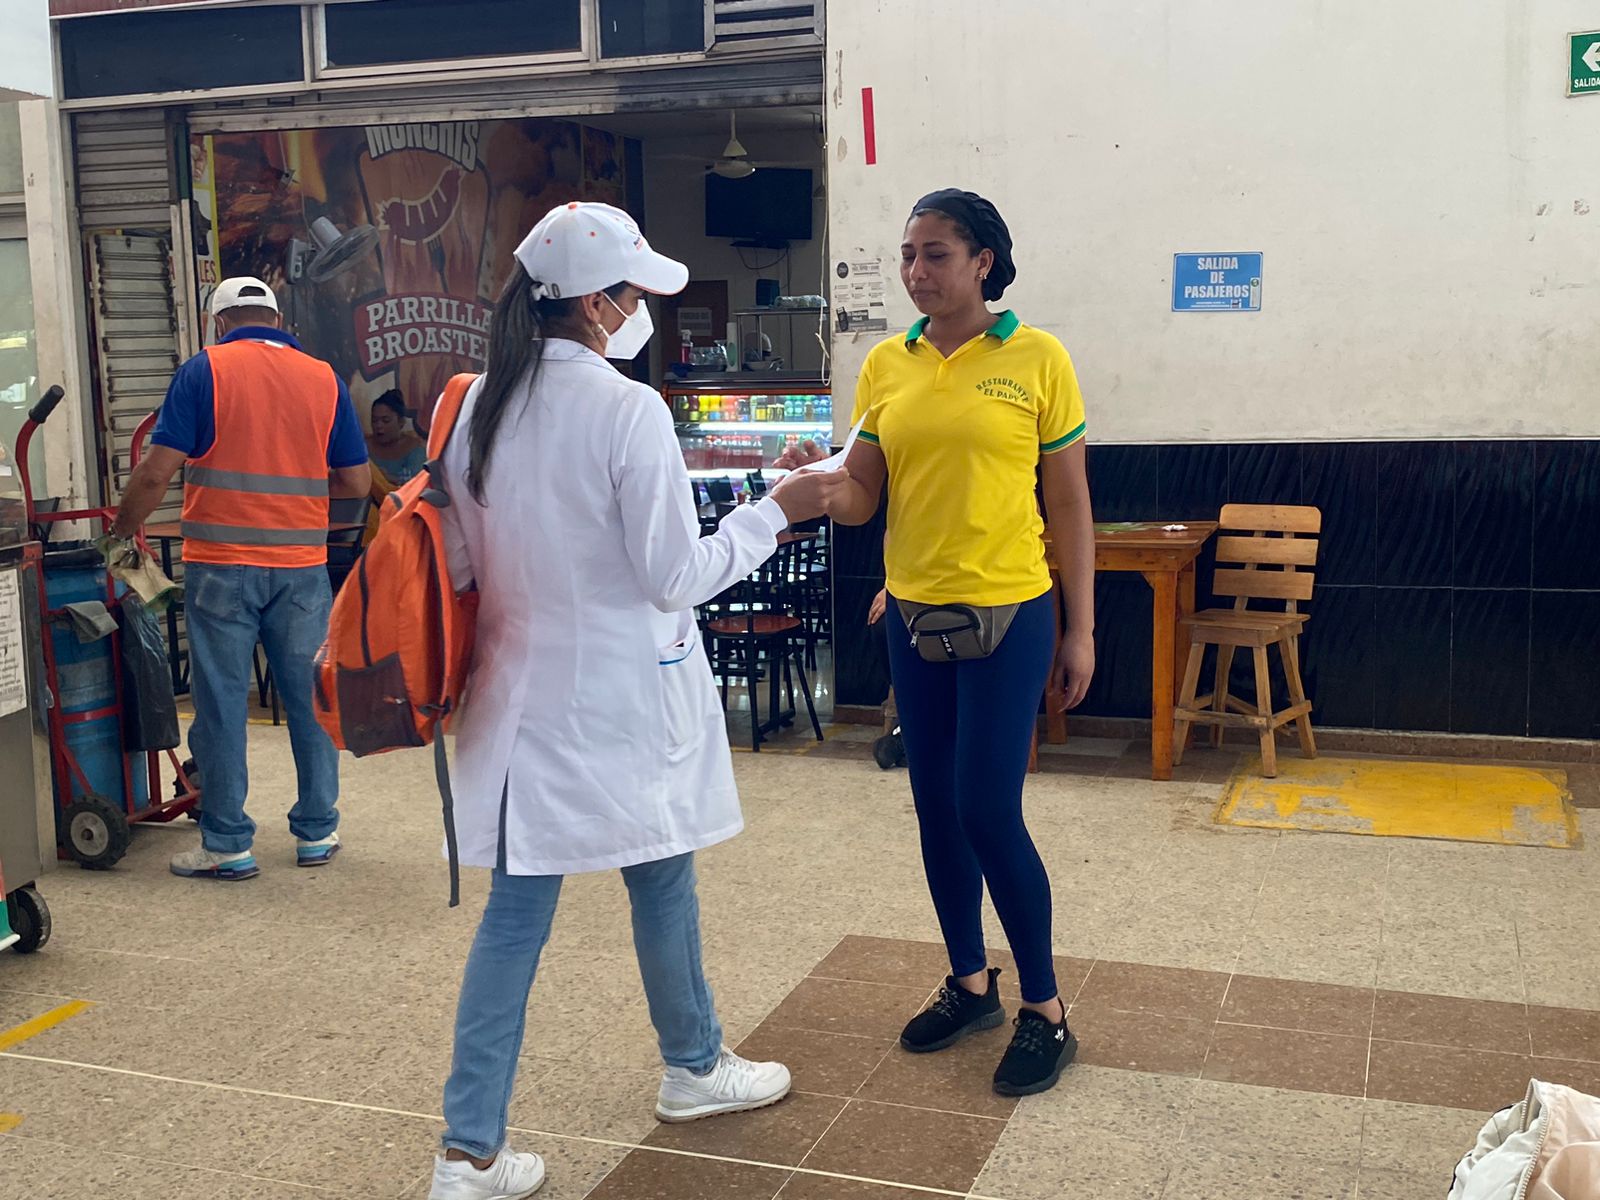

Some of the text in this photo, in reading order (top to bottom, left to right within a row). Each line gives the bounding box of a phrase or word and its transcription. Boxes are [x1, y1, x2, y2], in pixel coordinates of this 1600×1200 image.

[1197, 256, 1239, 271] SALIDA
[1209, 271, 1225, 284] DE
[1184, 285, 1250, 299] PASAJEROS
[976, 377, 1030, 403] RESTAURANTE
[983, 388, 995, 397] EL
